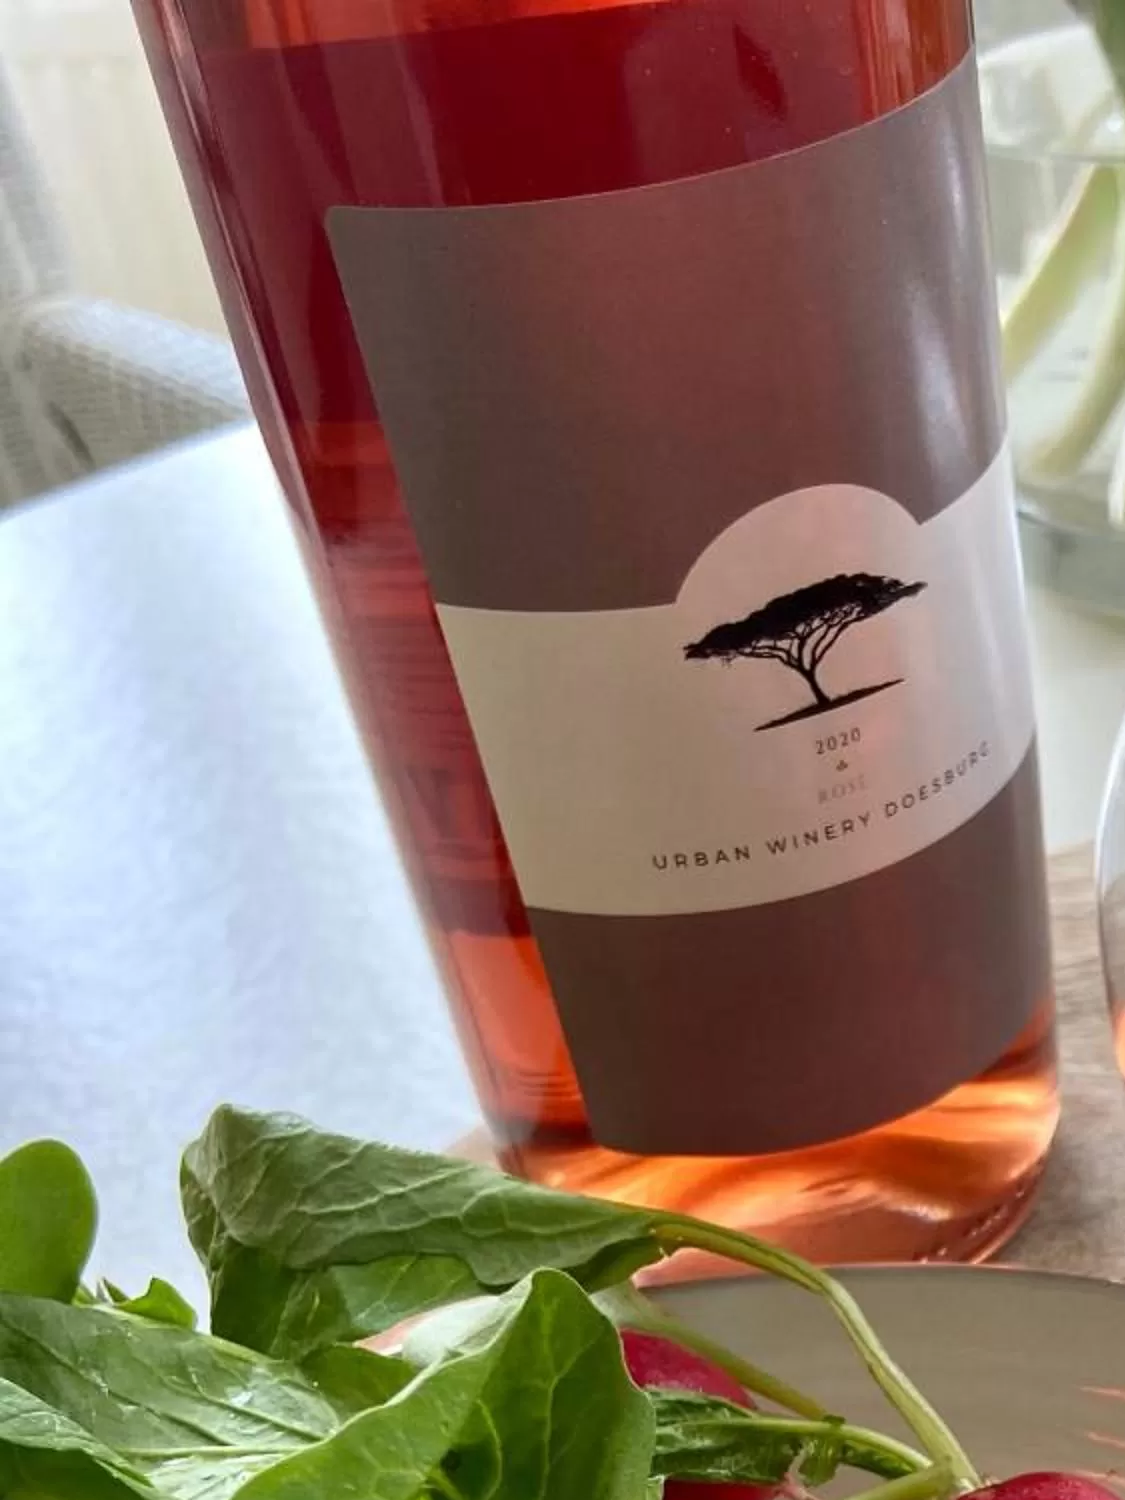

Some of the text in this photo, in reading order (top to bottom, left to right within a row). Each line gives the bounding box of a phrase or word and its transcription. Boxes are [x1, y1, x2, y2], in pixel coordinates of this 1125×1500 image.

[815, 727, 861, 755] 2020
[652, 740, 991, 870] URBAN WINERY DOESBURG
